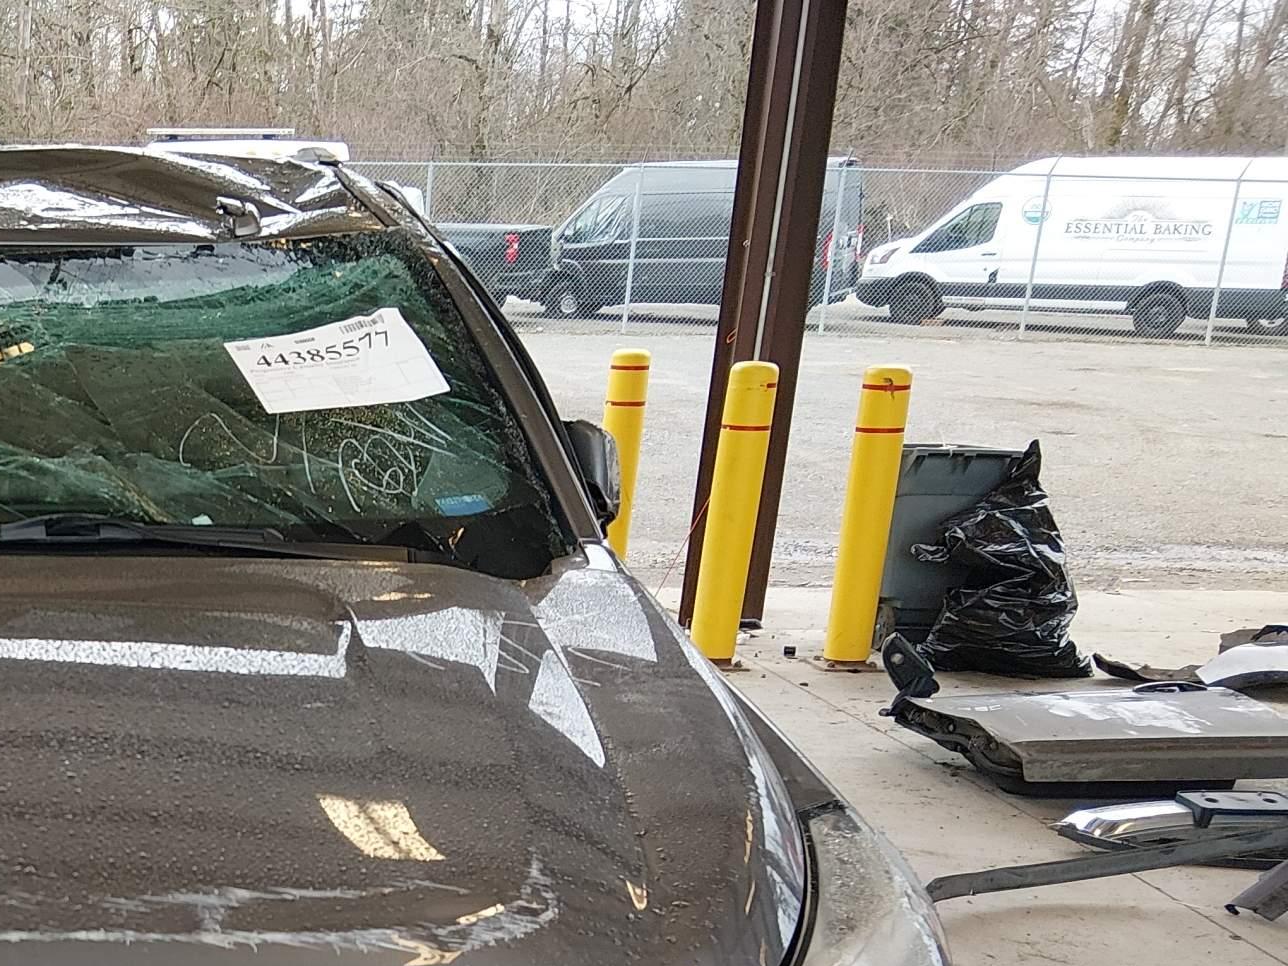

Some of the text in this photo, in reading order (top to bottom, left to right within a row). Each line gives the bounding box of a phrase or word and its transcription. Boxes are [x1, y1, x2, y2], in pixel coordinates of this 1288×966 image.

[1064, 222, 1214, 236] ESSENTIAL BAKING
[256, 329, 389, 368] 44385577
